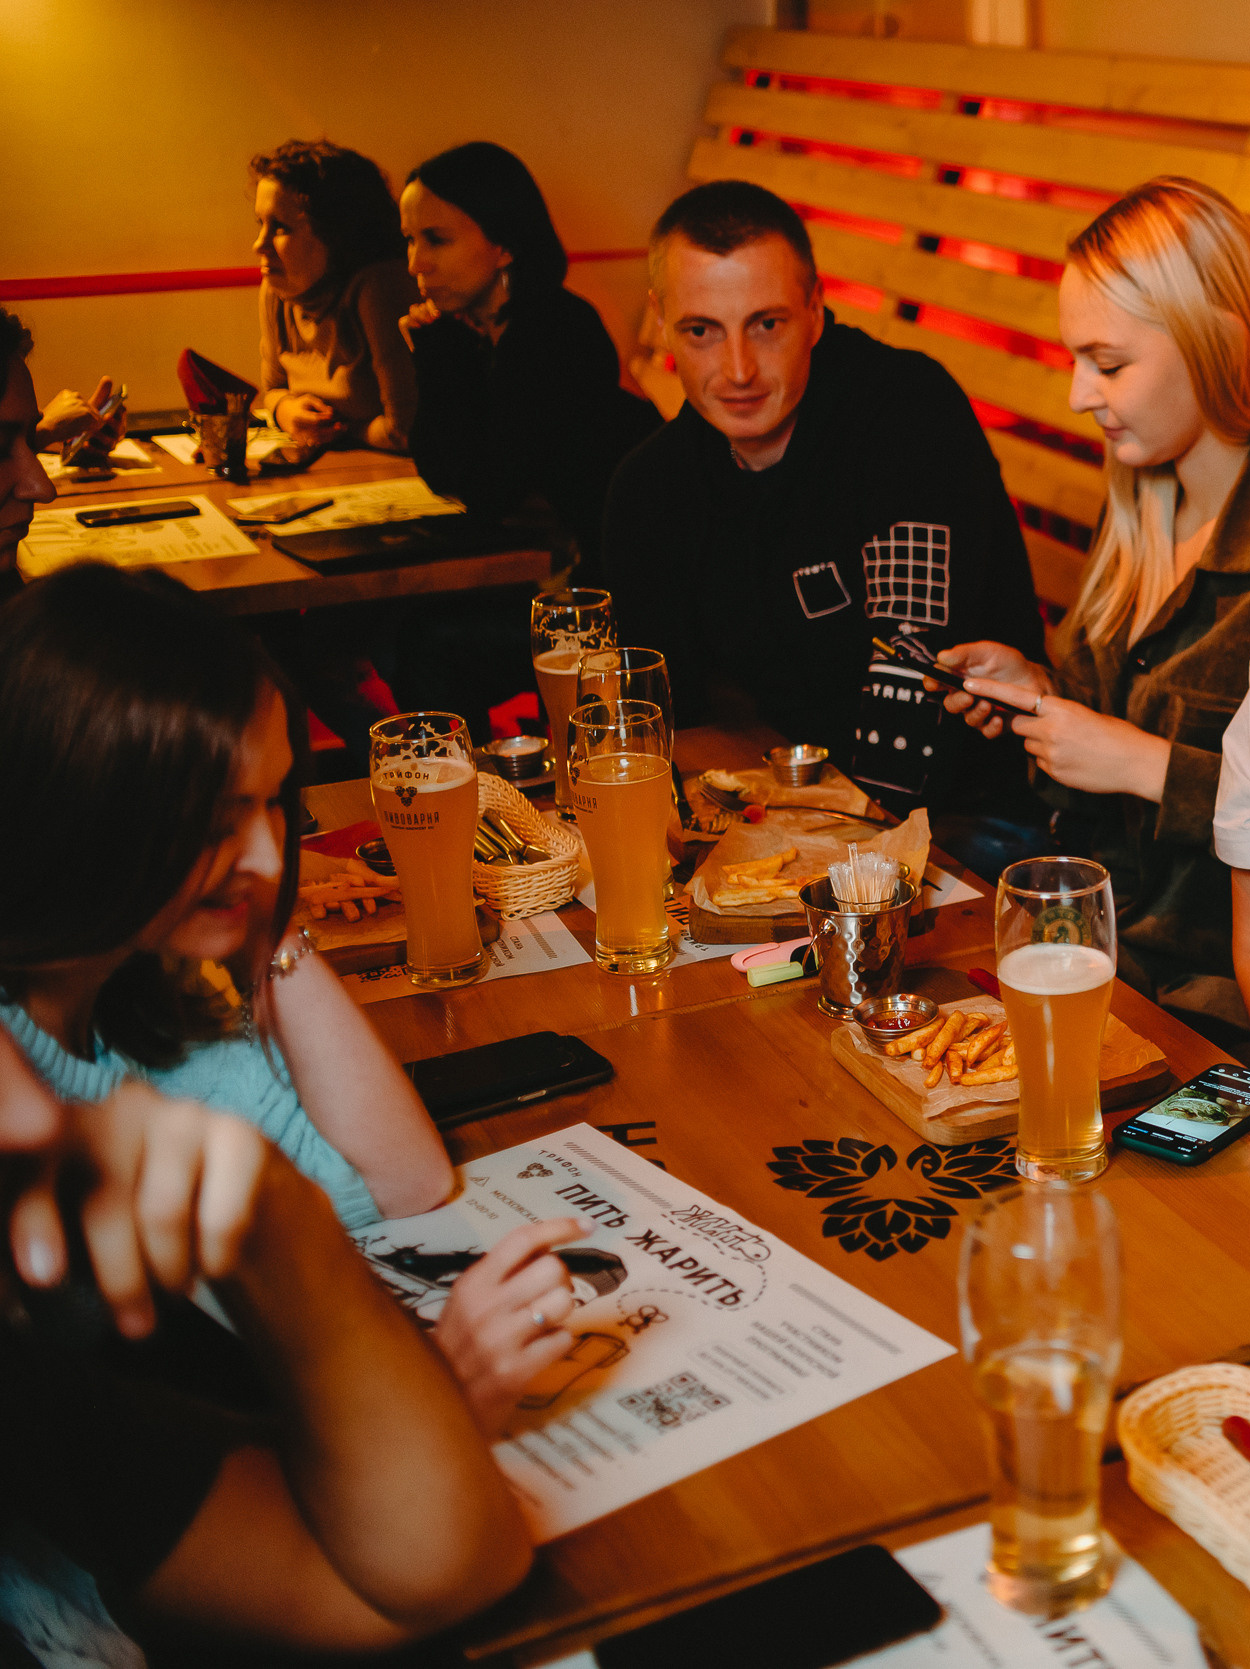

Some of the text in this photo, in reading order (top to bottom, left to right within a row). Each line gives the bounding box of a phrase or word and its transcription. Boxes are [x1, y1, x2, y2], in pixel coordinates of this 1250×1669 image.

[383, 771, 430, 780] ТРИФОН
[537, 1149, 583, 1178] ТРИФОН
[555, 1183, 634, 1229] ПИТЬ
[623, 1227, 748, 1307] ЖАРИТЬ
